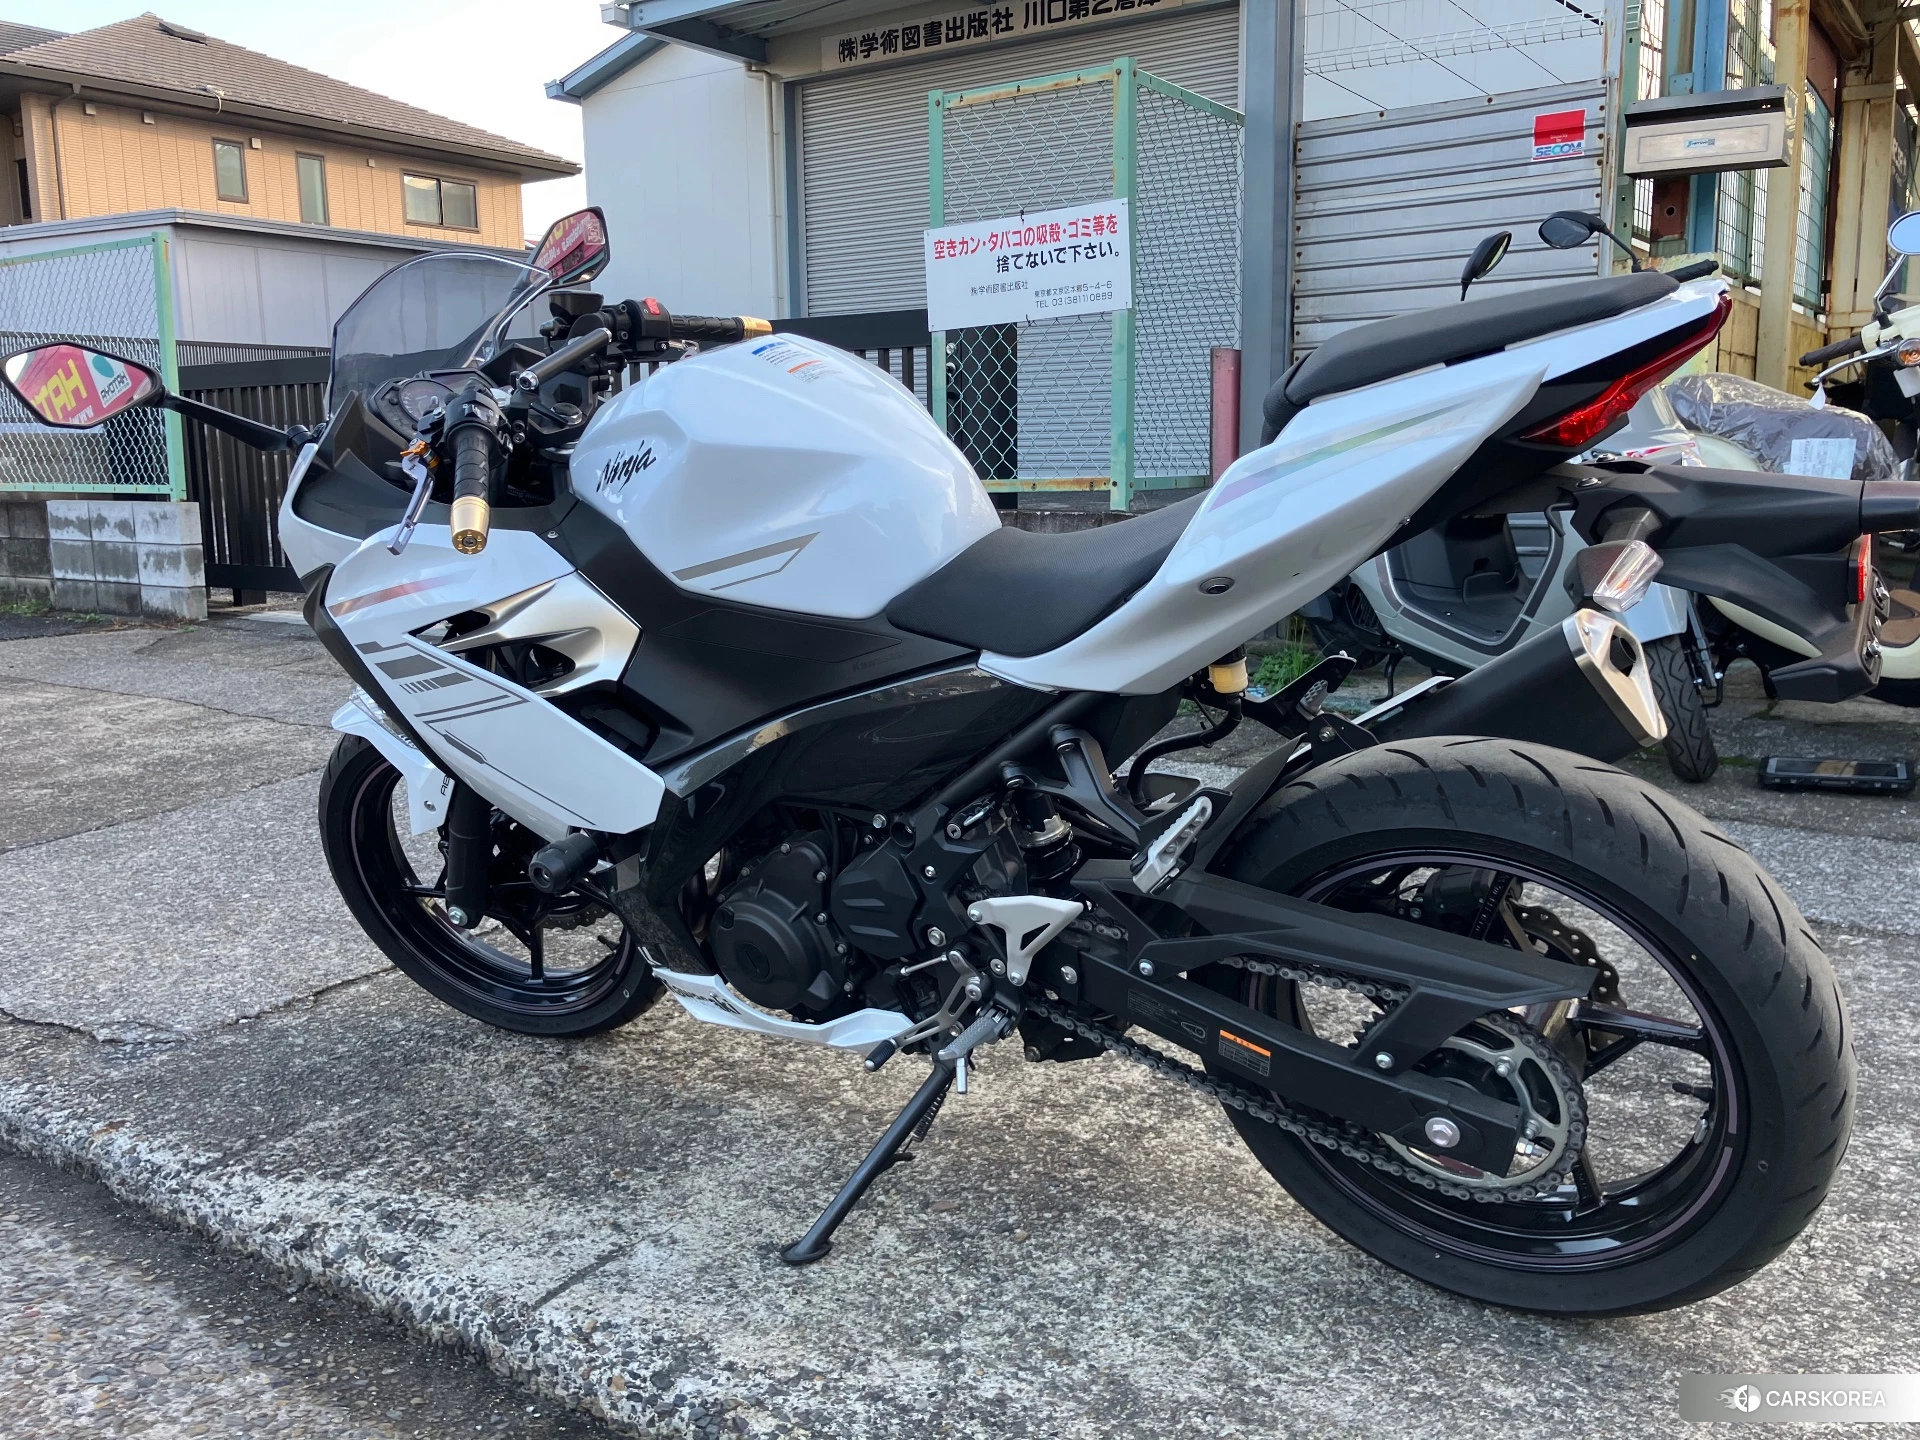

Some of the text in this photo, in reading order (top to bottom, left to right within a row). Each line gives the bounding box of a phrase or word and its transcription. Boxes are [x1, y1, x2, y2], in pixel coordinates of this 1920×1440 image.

[1023, 0, 1161, 30] 川口第2
[1536, 142, 1582, 157] SECOM
[933, 213, 1118, 260] 空きカン・タバコの吸殻・ゴミ等を
[996, 241, 1120, 273] 捨てないで下さい。
[1035, 300, 1049, 309] TEL
[596, 440, 656, 492] Ninja
[441, 774, 450, 796] AB
